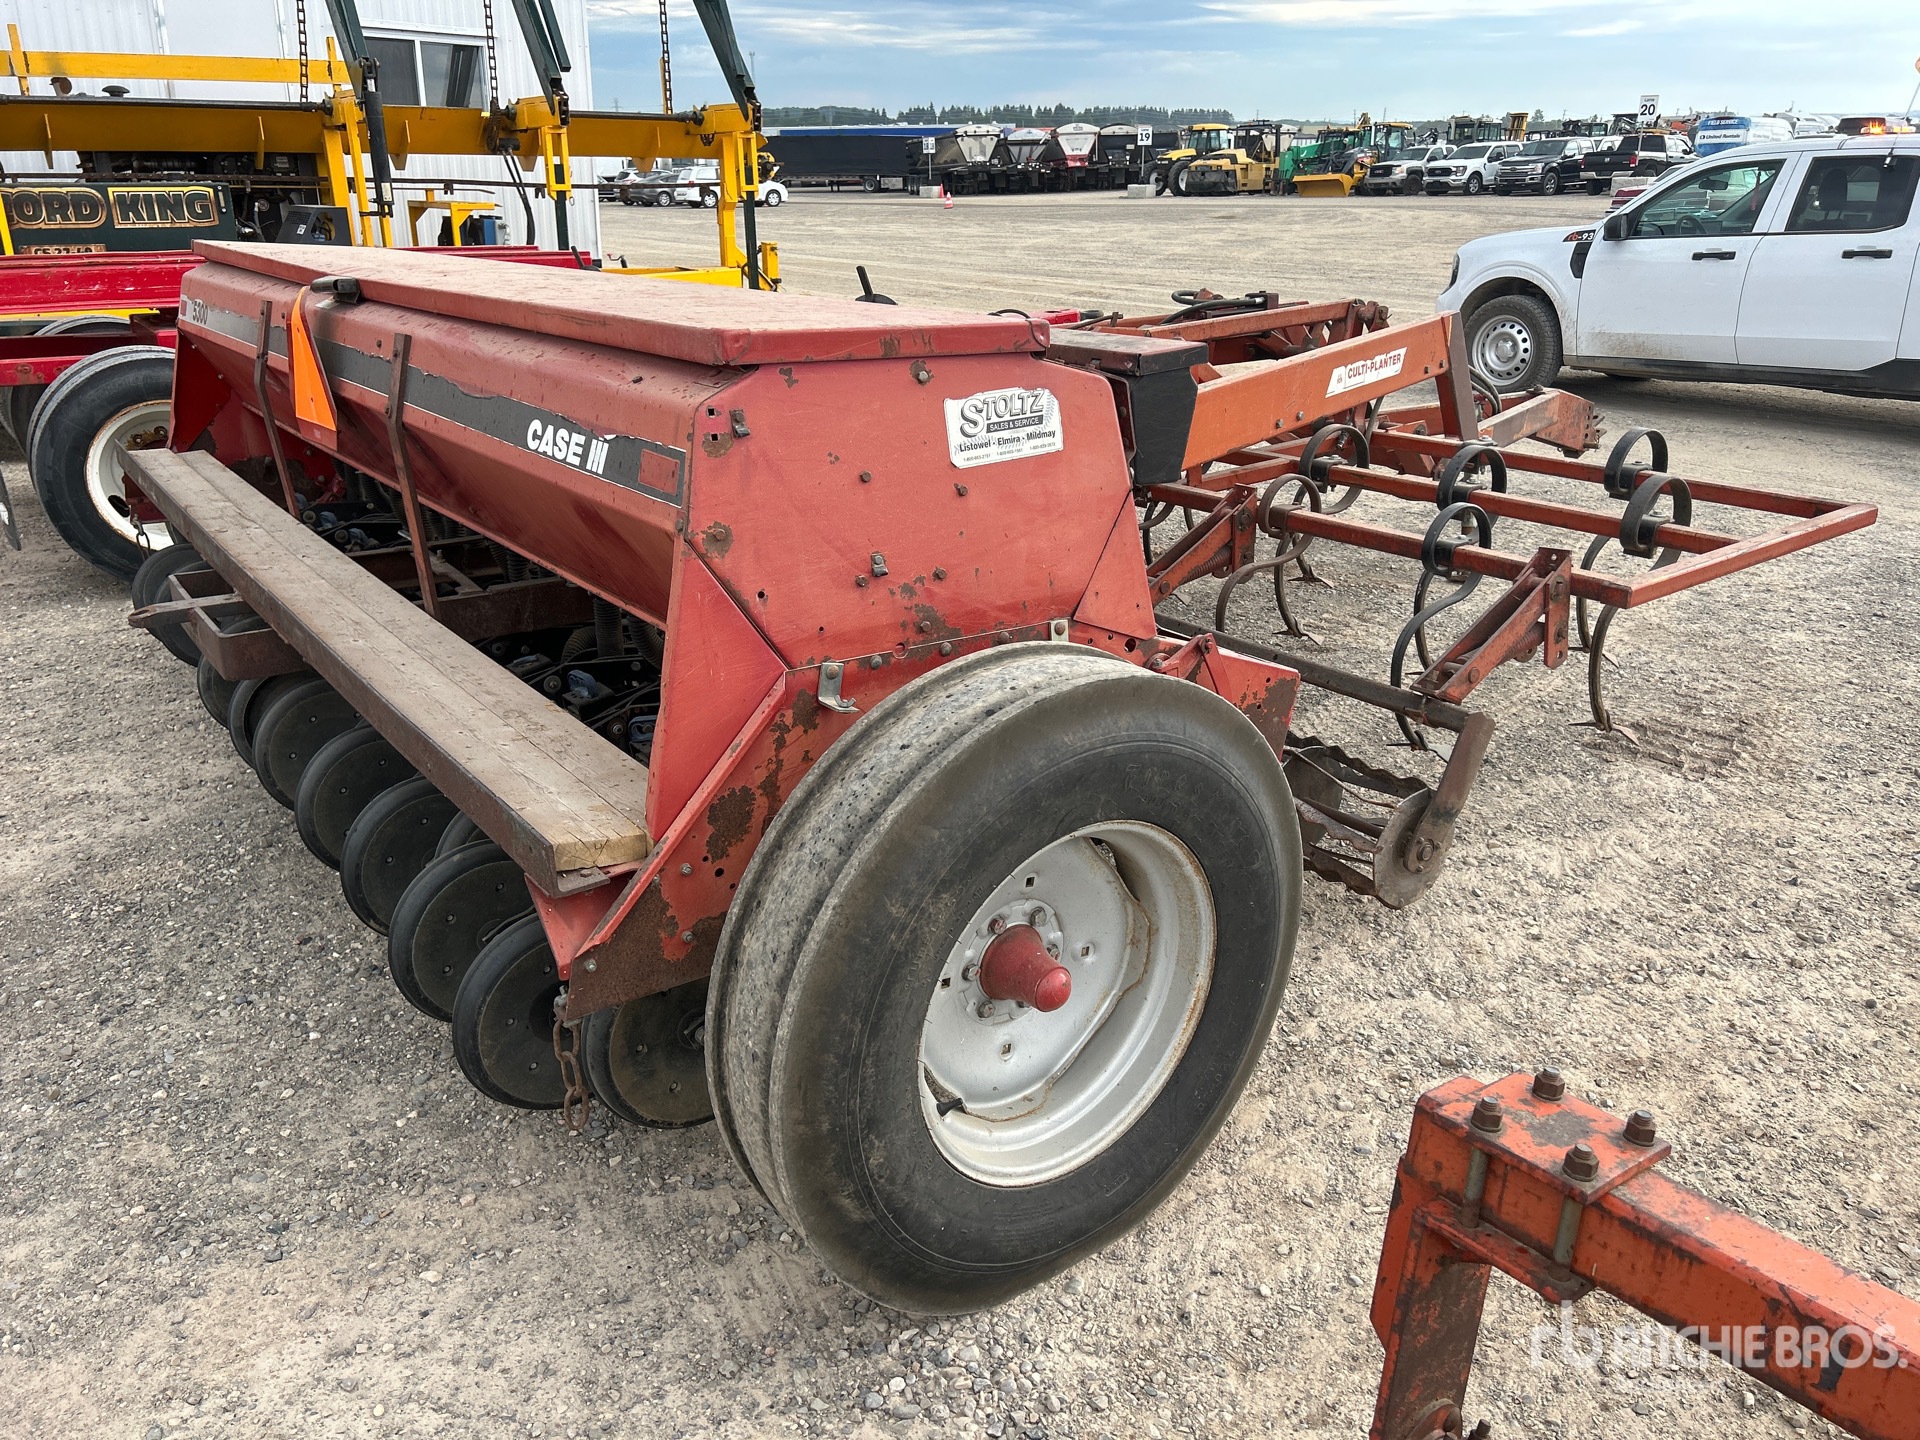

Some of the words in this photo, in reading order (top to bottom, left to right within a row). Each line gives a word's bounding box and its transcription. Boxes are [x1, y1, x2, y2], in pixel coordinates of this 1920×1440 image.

[1640, 104, 1656, 116] 20
[1139, 132, 1151, 142] 19
[113, 190, 214, 224] KING
[193, 300, 209, 325] 5300
[1347, 353, 1401, 379] CULTI-PLANTER
[960, 388, 1045, 439] STOLTZ
[989, 421, 1009, 432] SALES
[1015, 417, 1039, 427] SERVICE
[527, 419, 586, 466] CASE
[959, 439, 991, 452] Listowel
[998, 434, 1021, 446] Elmira
[1026, 429, 1056, 441] Mildmay
